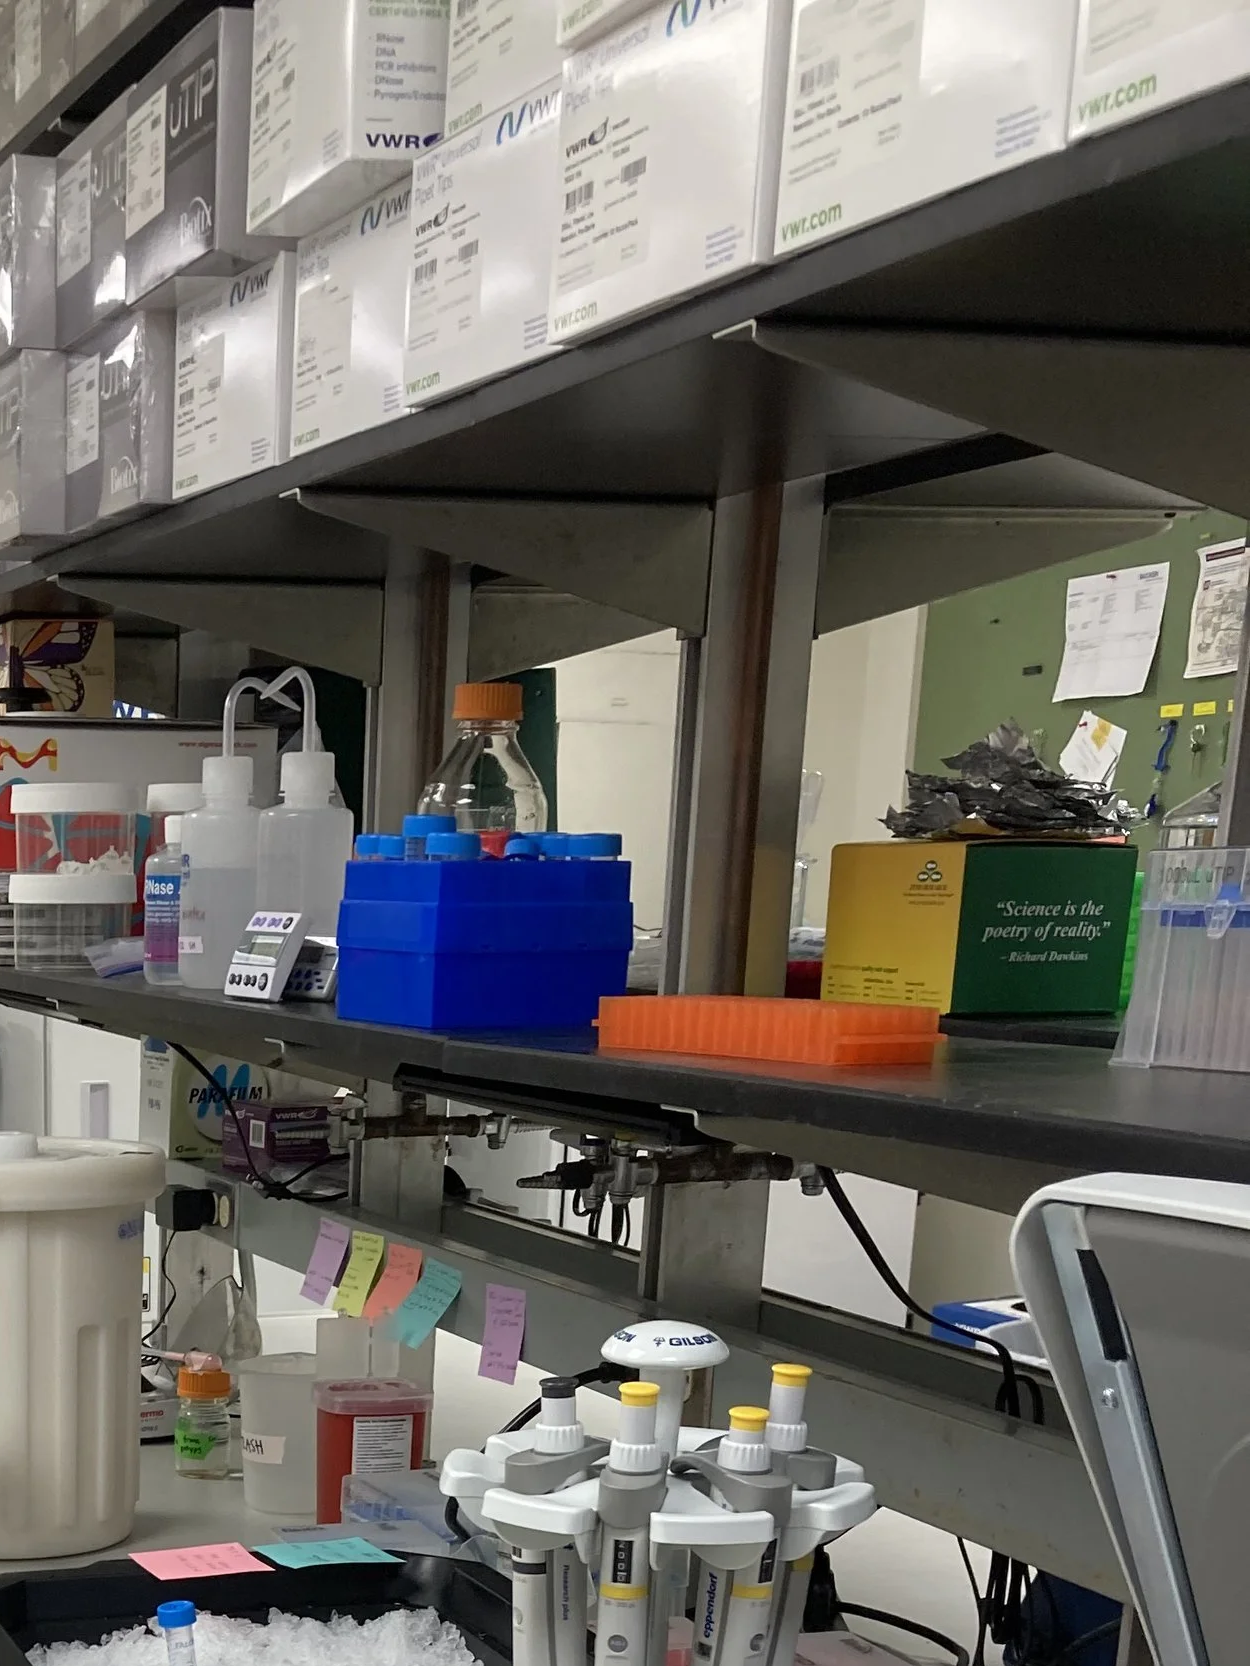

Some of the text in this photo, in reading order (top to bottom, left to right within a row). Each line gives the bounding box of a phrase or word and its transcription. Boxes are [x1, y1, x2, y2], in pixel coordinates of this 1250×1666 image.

[1078, 73, 1157, 122] vwr.com
[366, 133, 420, 149] VWR
[781, 203, 842, 242] vwr.com
[554, 301, 598, 332] vwr.com
[406, 372, 441, 396] vwr.com
[1064, 900, 1078, 916] is
[1080, 900, 1104, 916] the
[982, 925, 1031, 942] poetry
[1034, 921, 1055, 942] of
[1009, 951, 1048, 962] Richard
[1048, 950, 1088, 962] Dawkins
[275, 1112, 298, 1120] VWR
[669, 1333, 719, 1346] GILSON
[140, 1409, 164, 1418] ermo
[561, 1603, 569, 1621] plus
[703, 1571, 718, 1639] eppendorf
